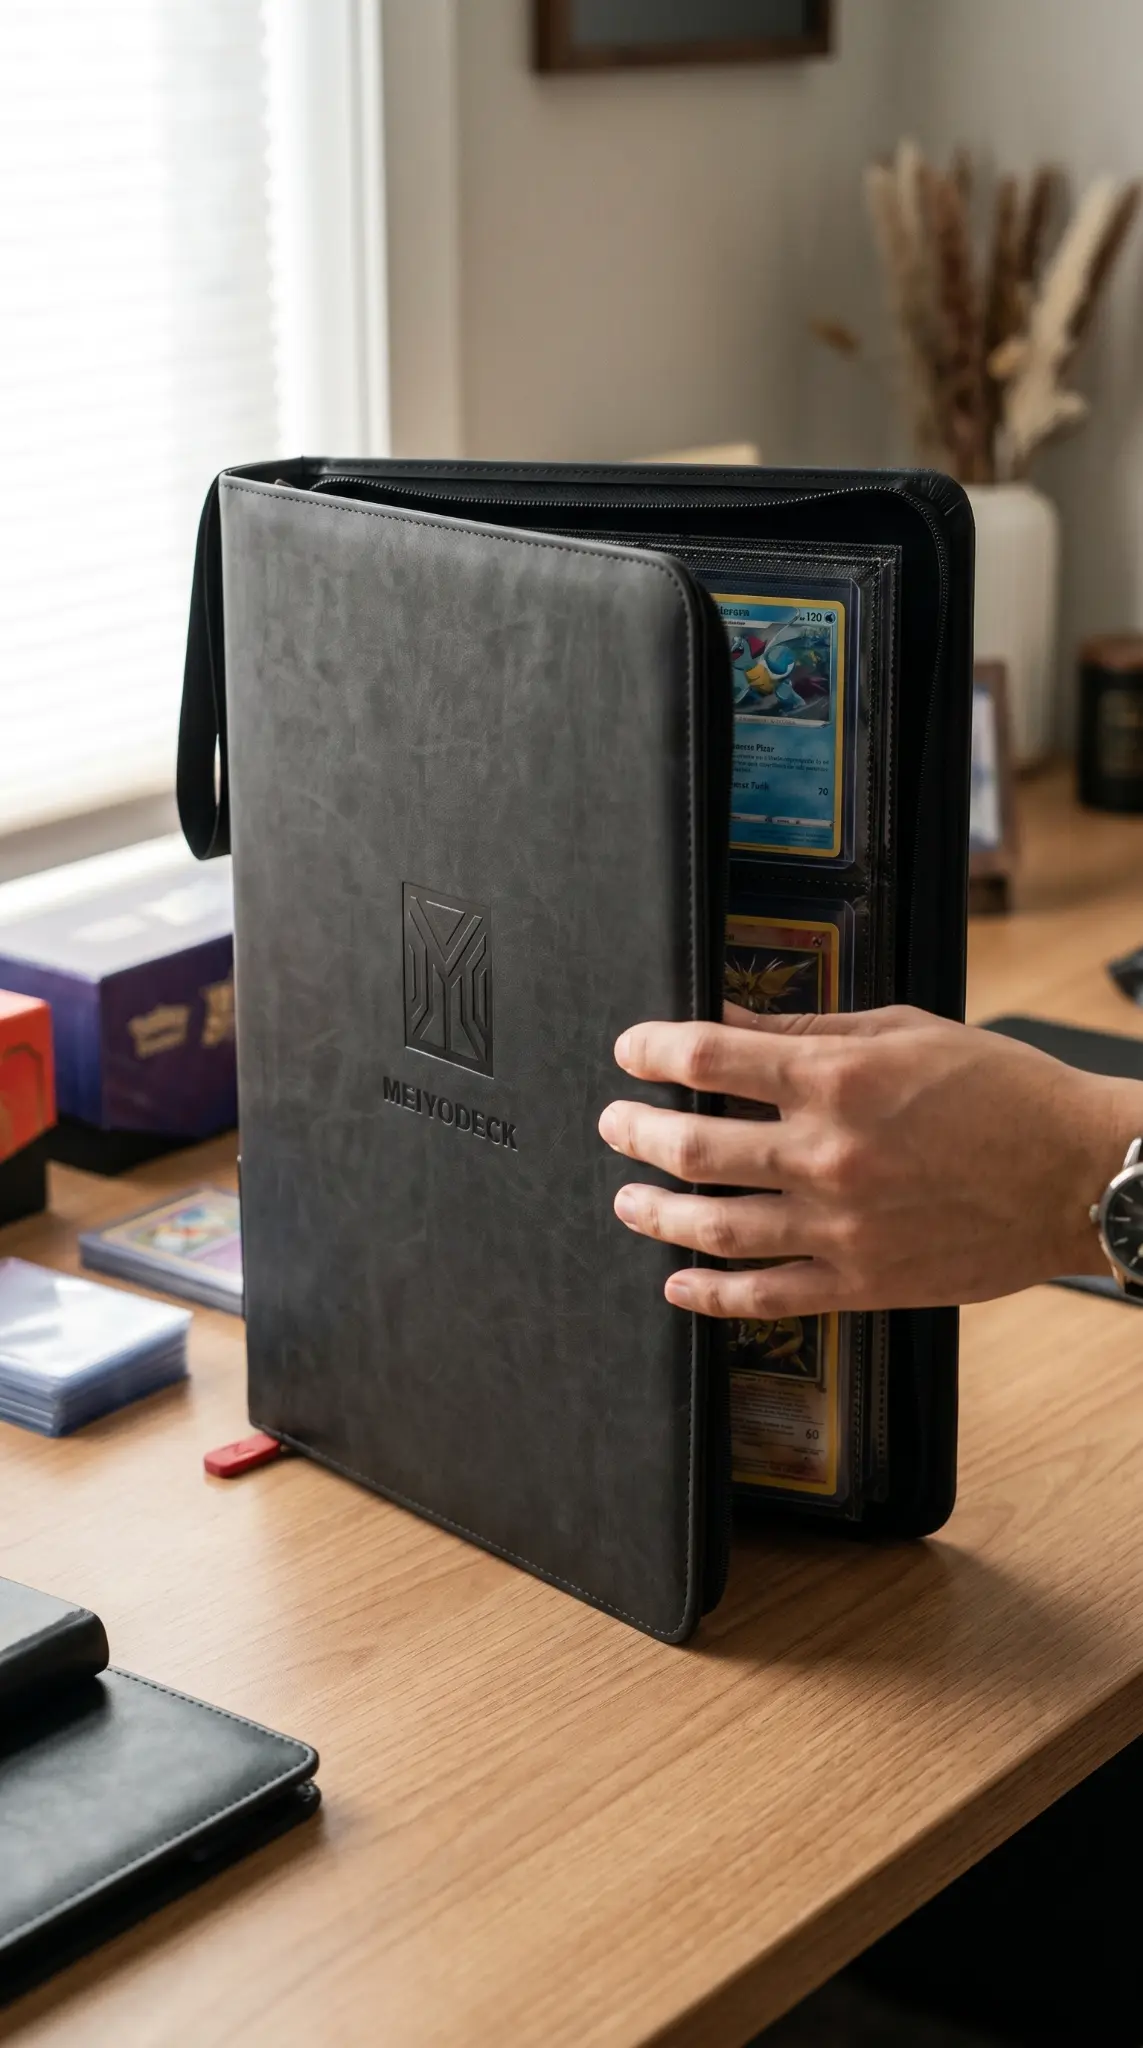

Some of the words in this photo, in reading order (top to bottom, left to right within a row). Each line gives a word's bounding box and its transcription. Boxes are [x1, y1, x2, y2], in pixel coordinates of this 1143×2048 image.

[806, 612, 822, 622] 120
[818, 787, 829, 796] 70
[383, 1076, 518, 1151] MEIYODECK
[805, 1428, 819, 1440] 60
